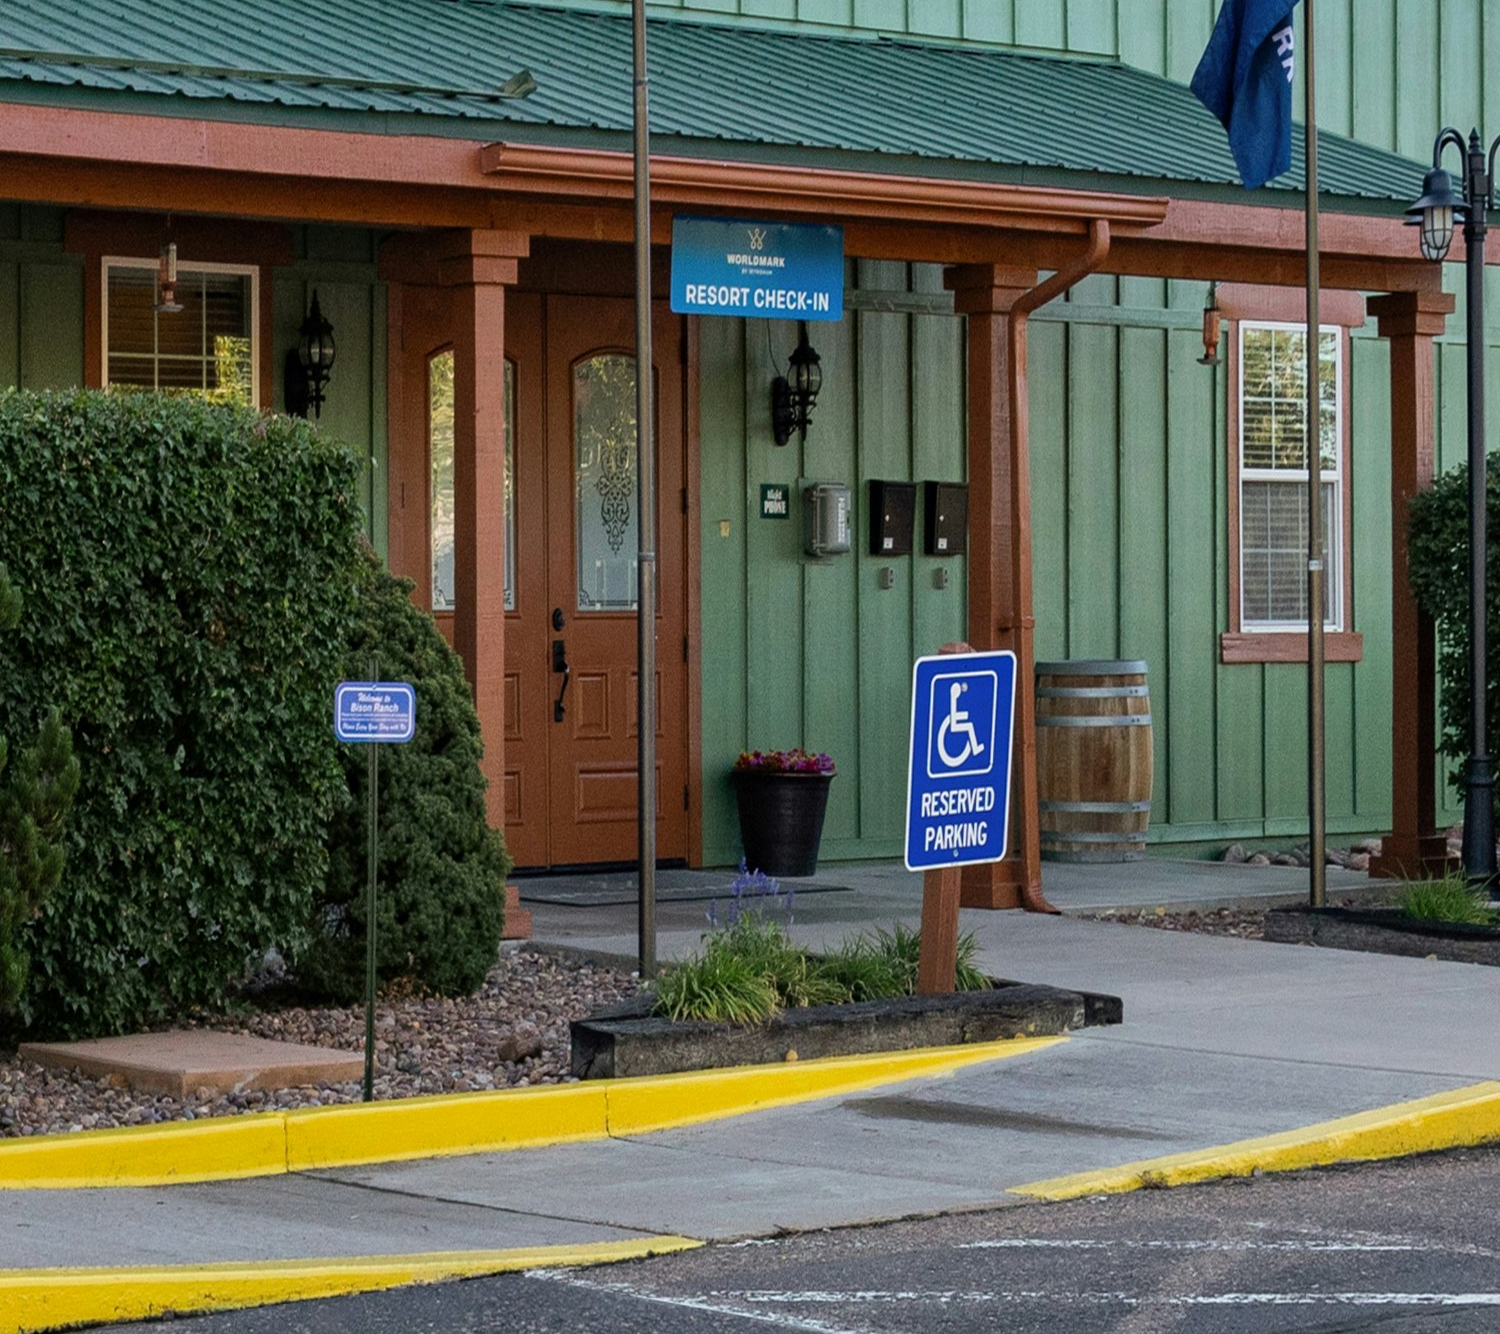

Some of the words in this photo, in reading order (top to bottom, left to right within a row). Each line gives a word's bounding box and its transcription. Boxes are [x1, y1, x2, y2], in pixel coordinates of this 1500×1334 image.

[726, 253, 786, 268] WORLDMARK
[685, 283, 750, 307] RESORT
[753, 288, 830, 313] CHECK-IN
[351, 702, 372, 712] Bison
[374, 702, 399, 712] Ranch
[921, 786, 995, 818] RESERVED
[924, 821, 988, 852] PARKING
